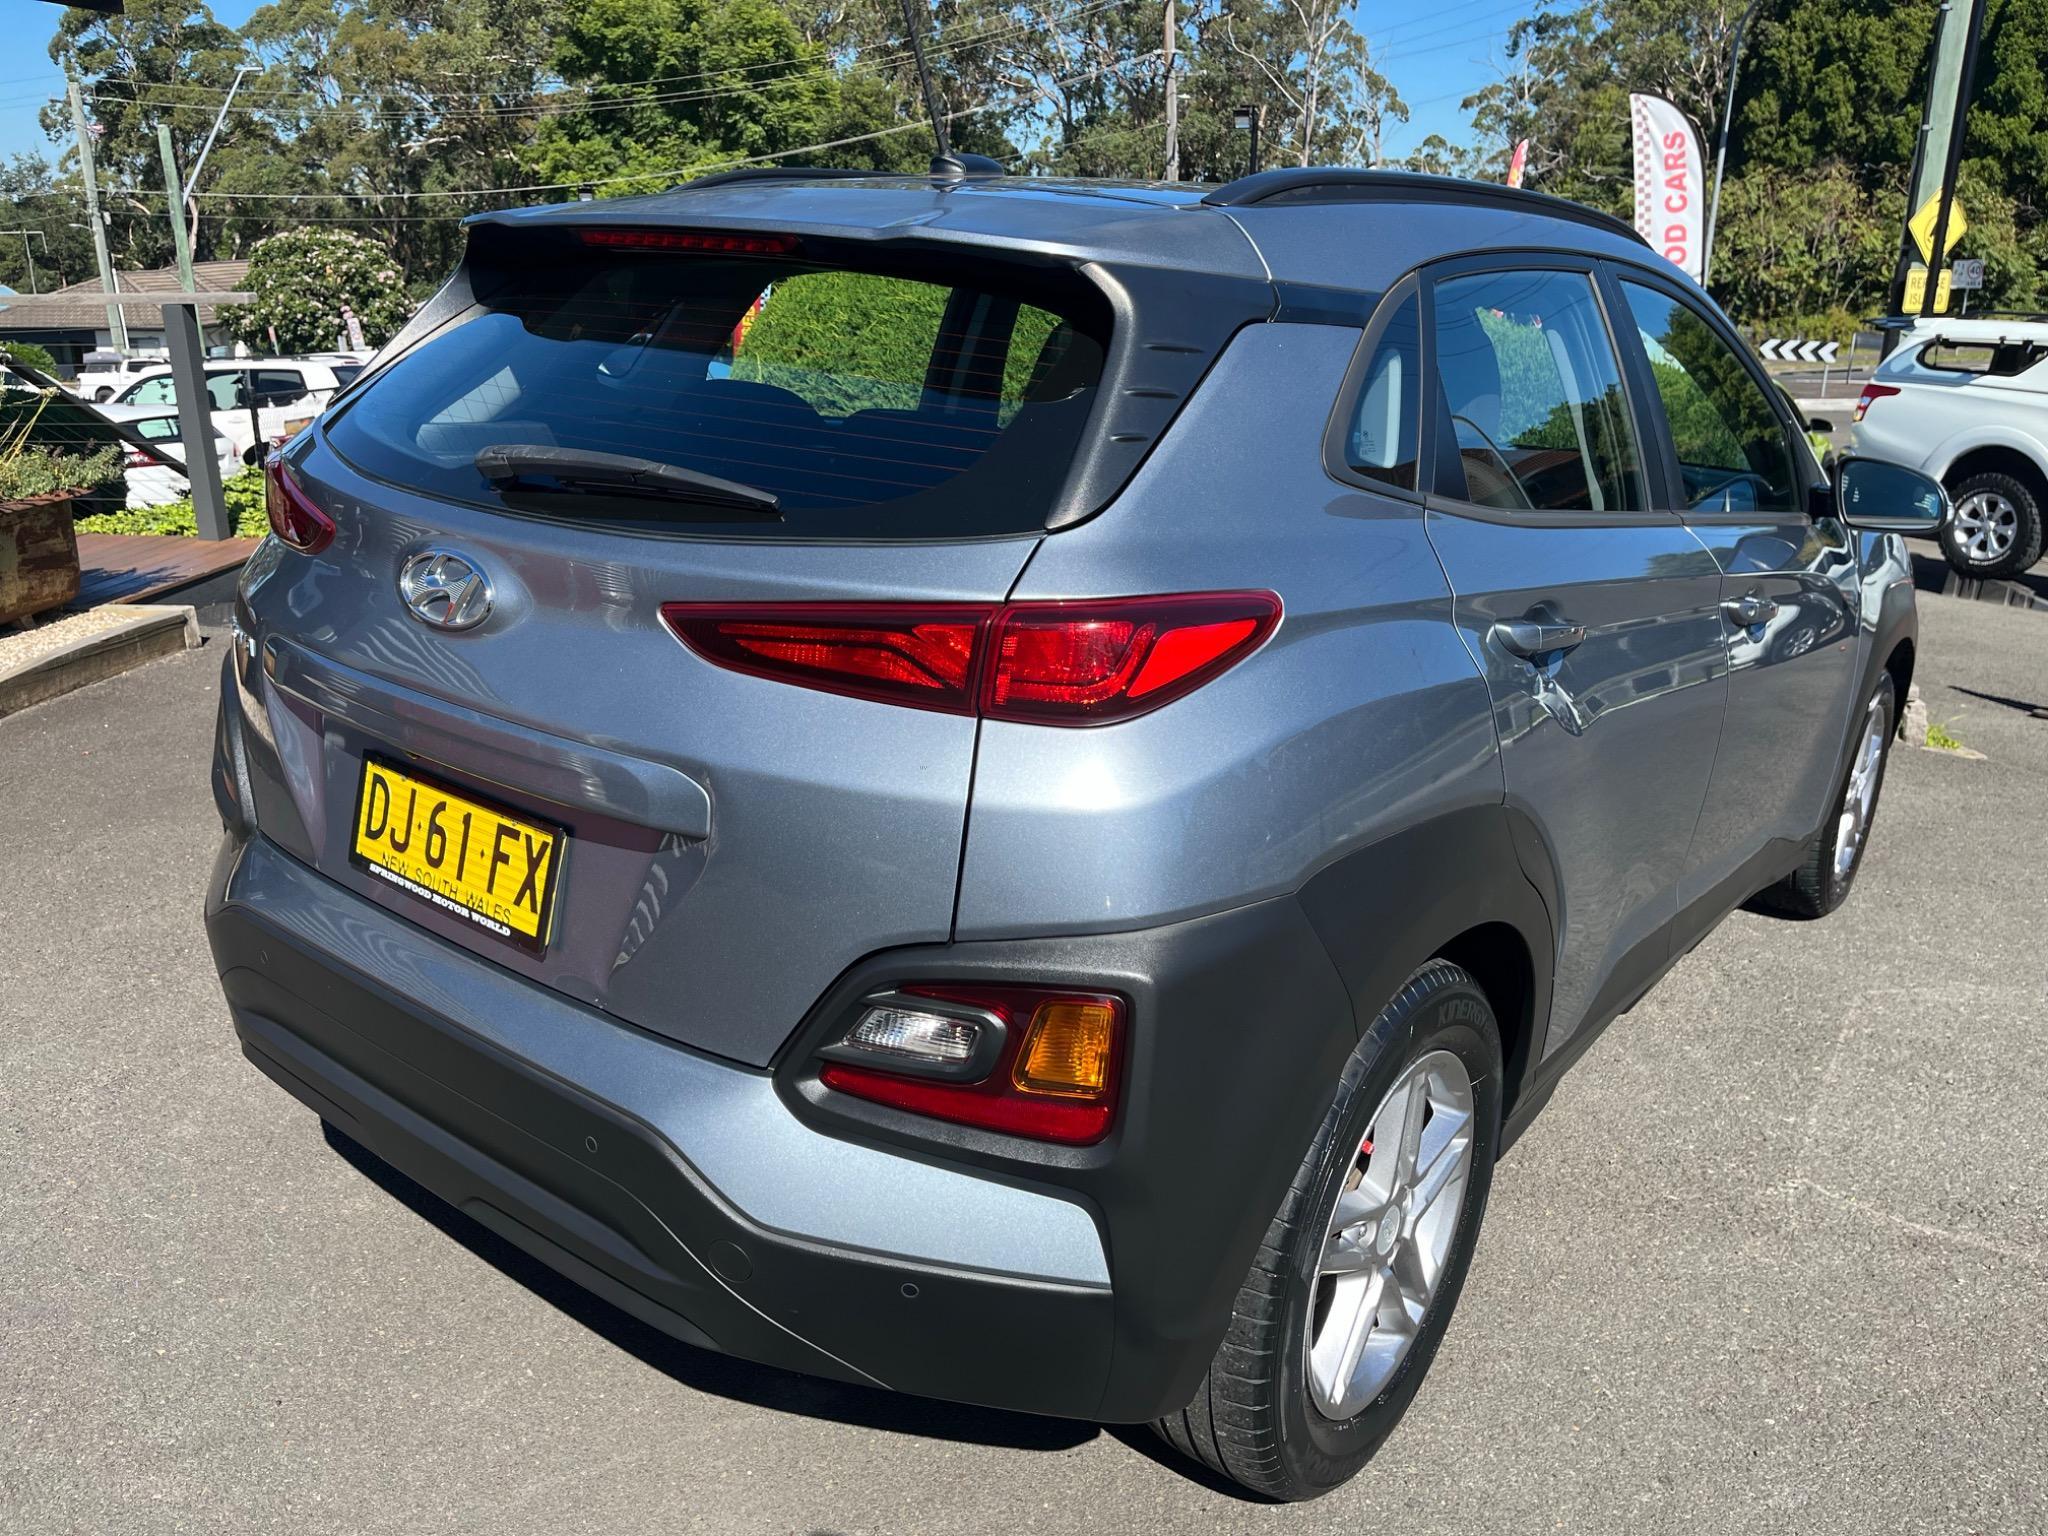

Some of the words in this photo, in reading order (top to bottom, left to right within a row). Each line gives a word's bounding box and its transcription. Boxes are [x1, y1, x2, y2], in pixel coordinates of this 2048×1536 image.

[1663, 131, 1688, 213] CARS
[1909, 293, 1943, 305] ISLD
[1911, 277, 1946, 289] REE
[369, 863, 433, 900] SPRINGWOOD
[432, 896, 470, 918] MOTOR
[470, 911, 511, 936] WORLD
[381, 853, 409, 877] NEW
[415, 867, 459, 901] SOUTH
[465, 888, 512, 925] WALES
